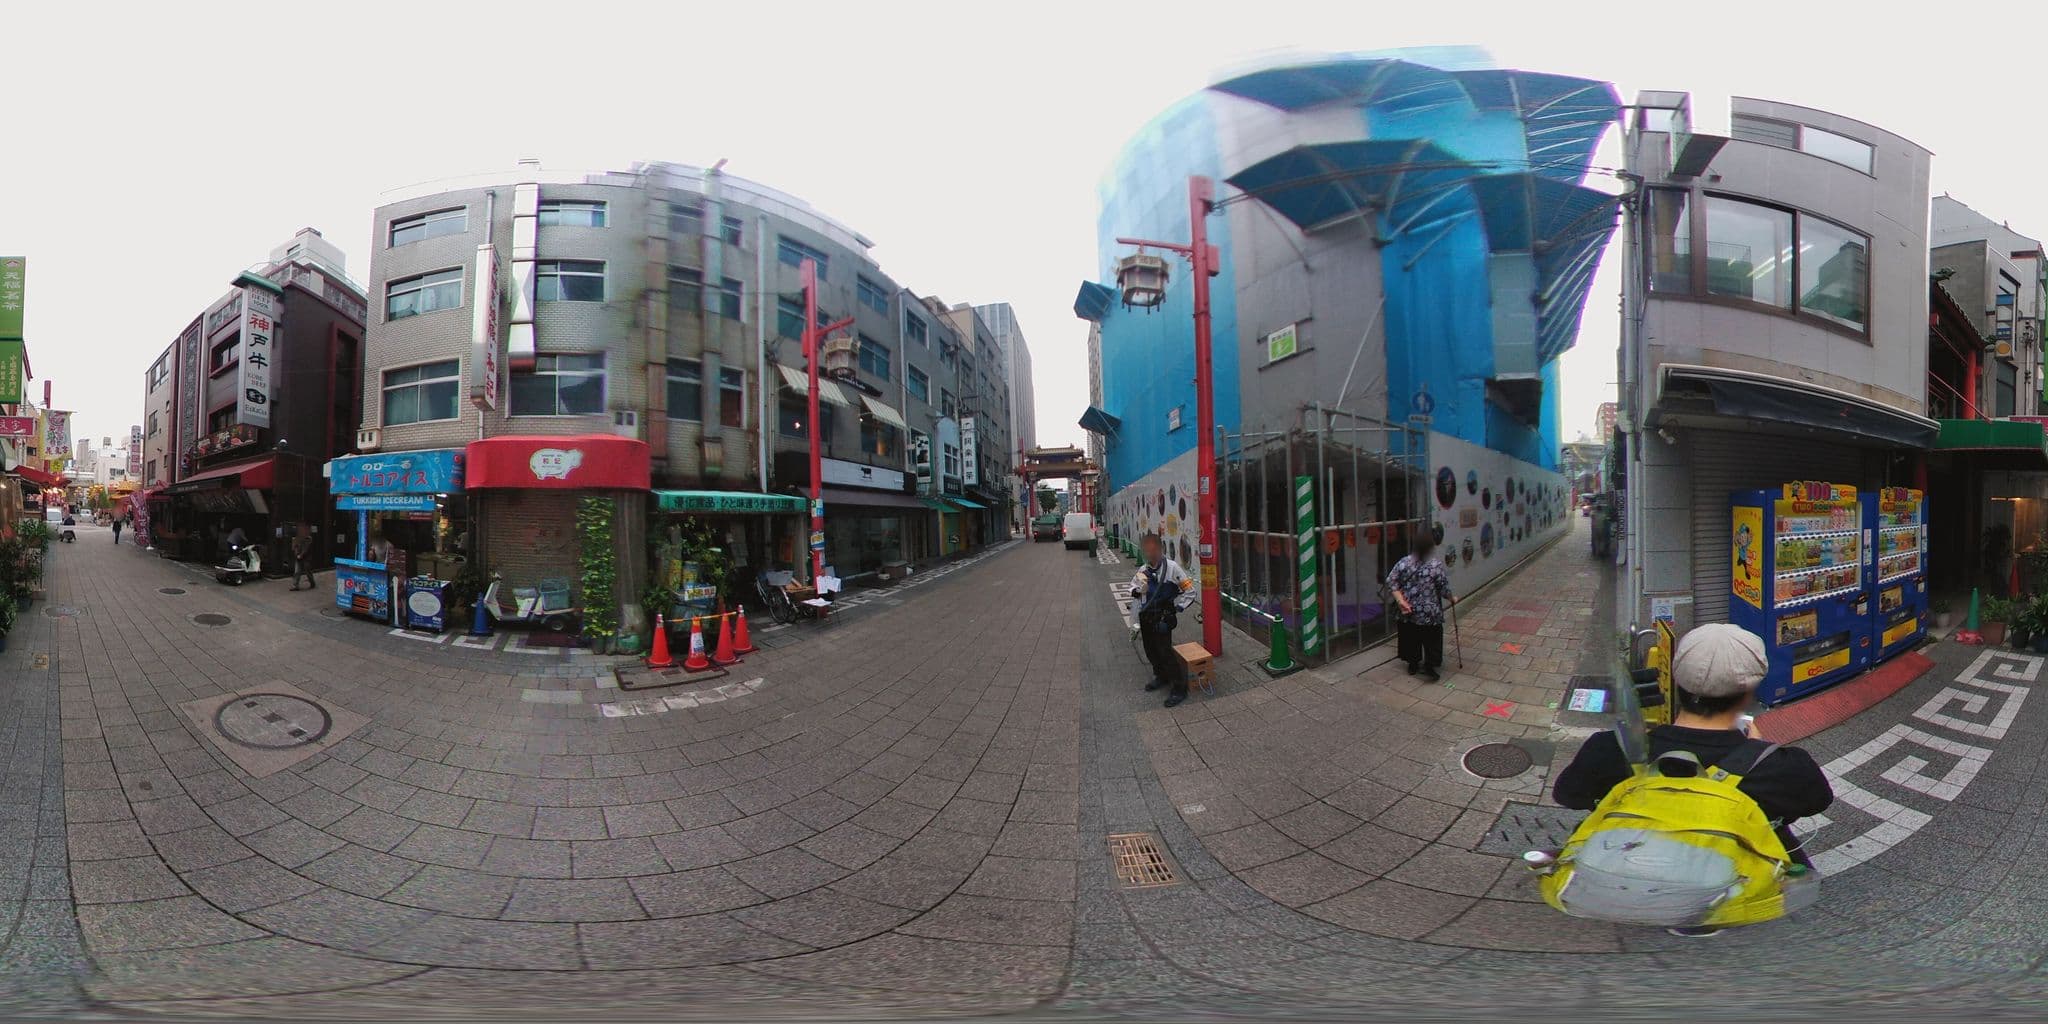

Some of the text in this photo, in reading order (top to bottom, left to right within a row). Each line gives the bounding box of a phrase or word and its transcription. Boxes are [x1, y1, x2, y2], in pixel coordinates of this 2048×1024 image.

[248, 313, 270, 371] 神戸牛
[349, 471, 428, 489] トルコアイス
[352, 496, 424, 504] TURKISH ICECREAM
